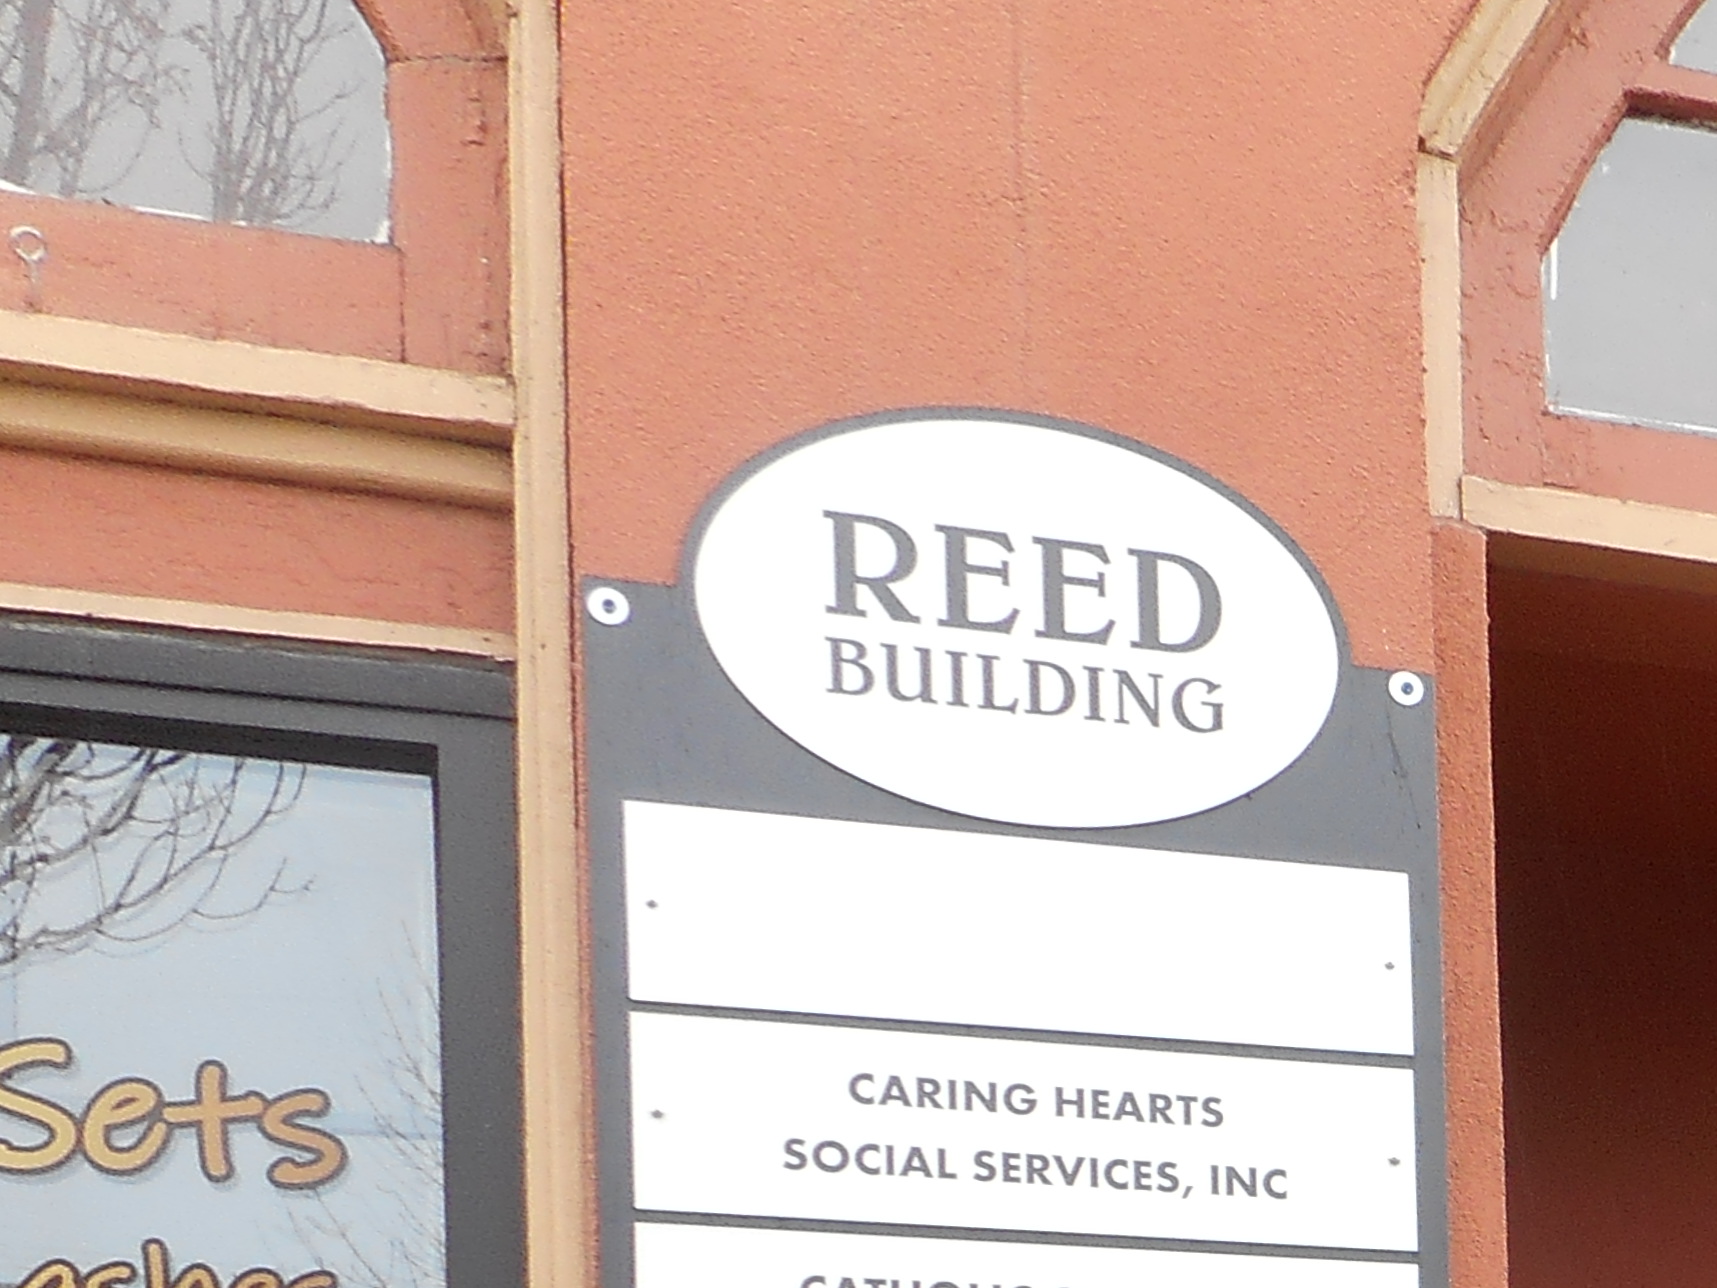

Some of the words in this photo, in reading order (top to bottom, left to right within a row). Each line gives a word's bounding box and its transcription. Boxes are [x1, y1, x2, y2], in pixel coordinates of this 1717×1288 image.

[822, 509, 1223, 654] REED
[824, 635, 1225, 734] BUILDING
[0, 1036, 347, 1190] Sets
[849, 1073, 1037, 1115] CARING
[1055, 1086, 1224, 1128] HEARTS
[784, 1138, 957, 1179] SOCIAL
[974, 1150, 1192, 1199] SERVICES,
[1211, 1165, 1287, 1200] INC
